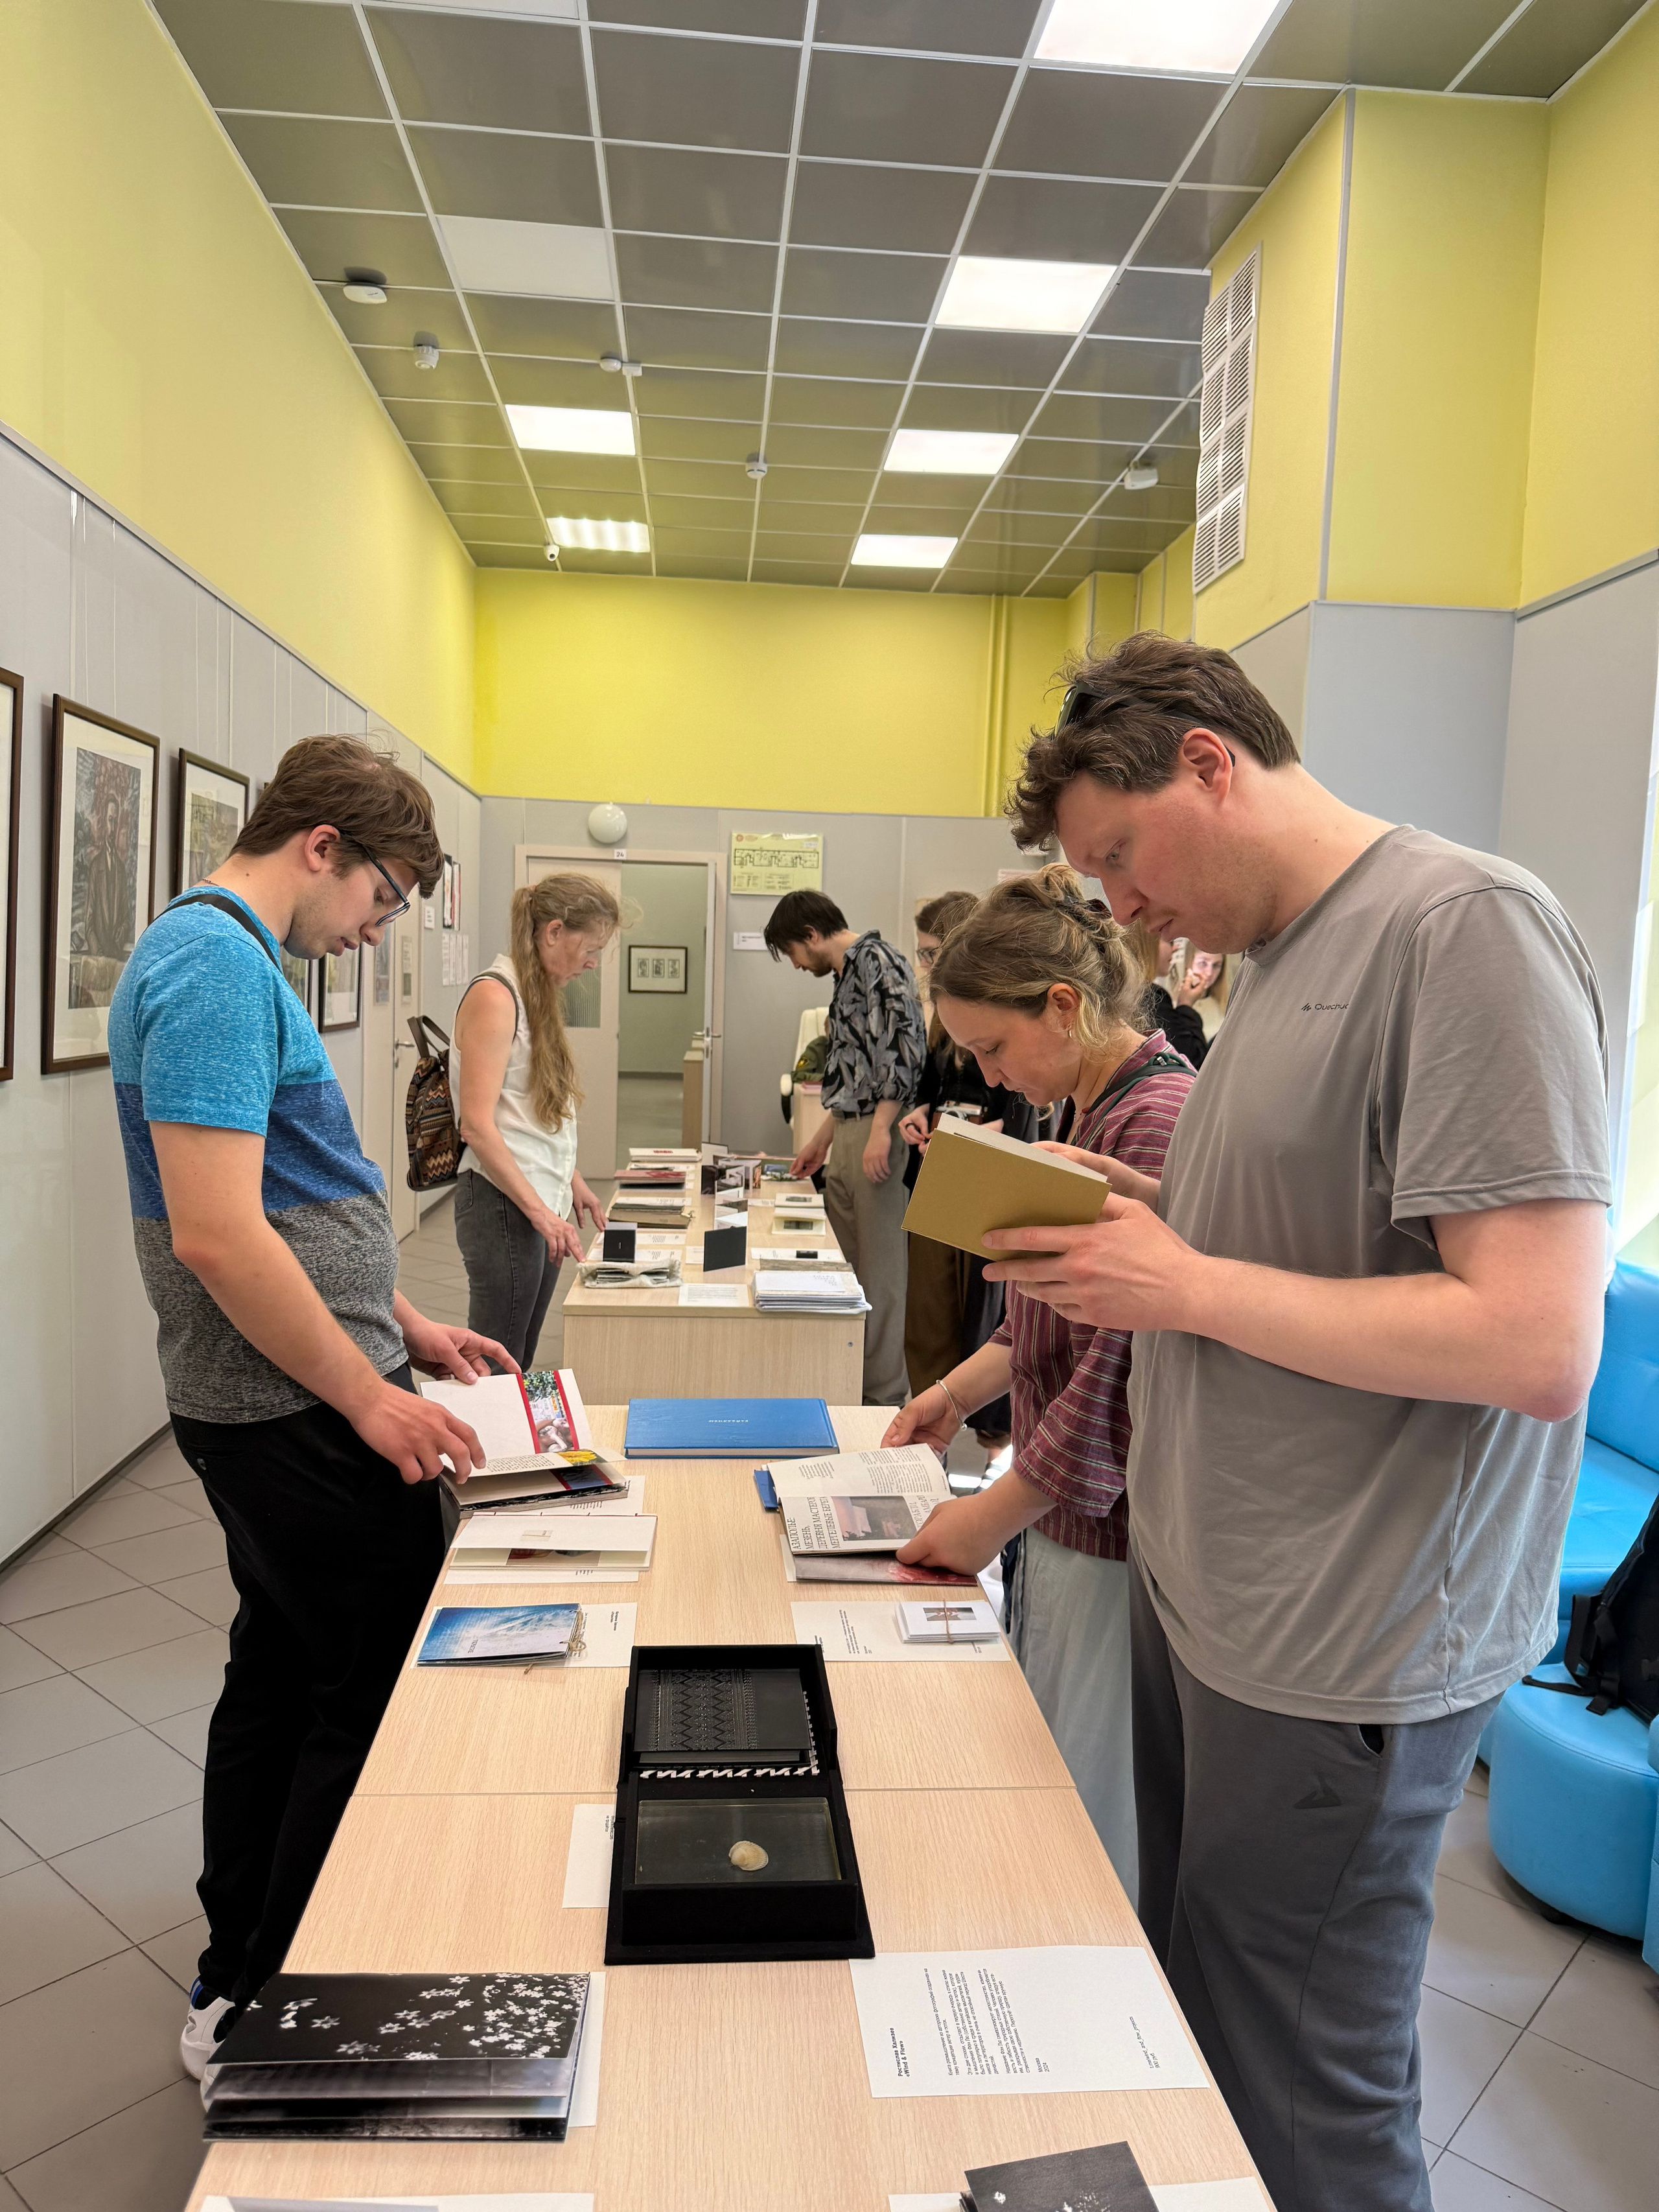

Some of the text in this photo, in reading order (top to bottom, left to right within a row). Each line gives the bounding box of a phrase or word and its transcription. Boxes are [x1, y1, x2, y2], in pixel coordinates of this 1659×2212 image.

[802, 1525, 814, 1549] МЕЗЕНЬ,
[814, 1524, 828, 1548] ДЕРЕВНЯ
[824, 1512, 841, 1548] МЕРГЕЛЕВЫЕ
[889, 2027, 903, 2077] Ростислав Хализев
